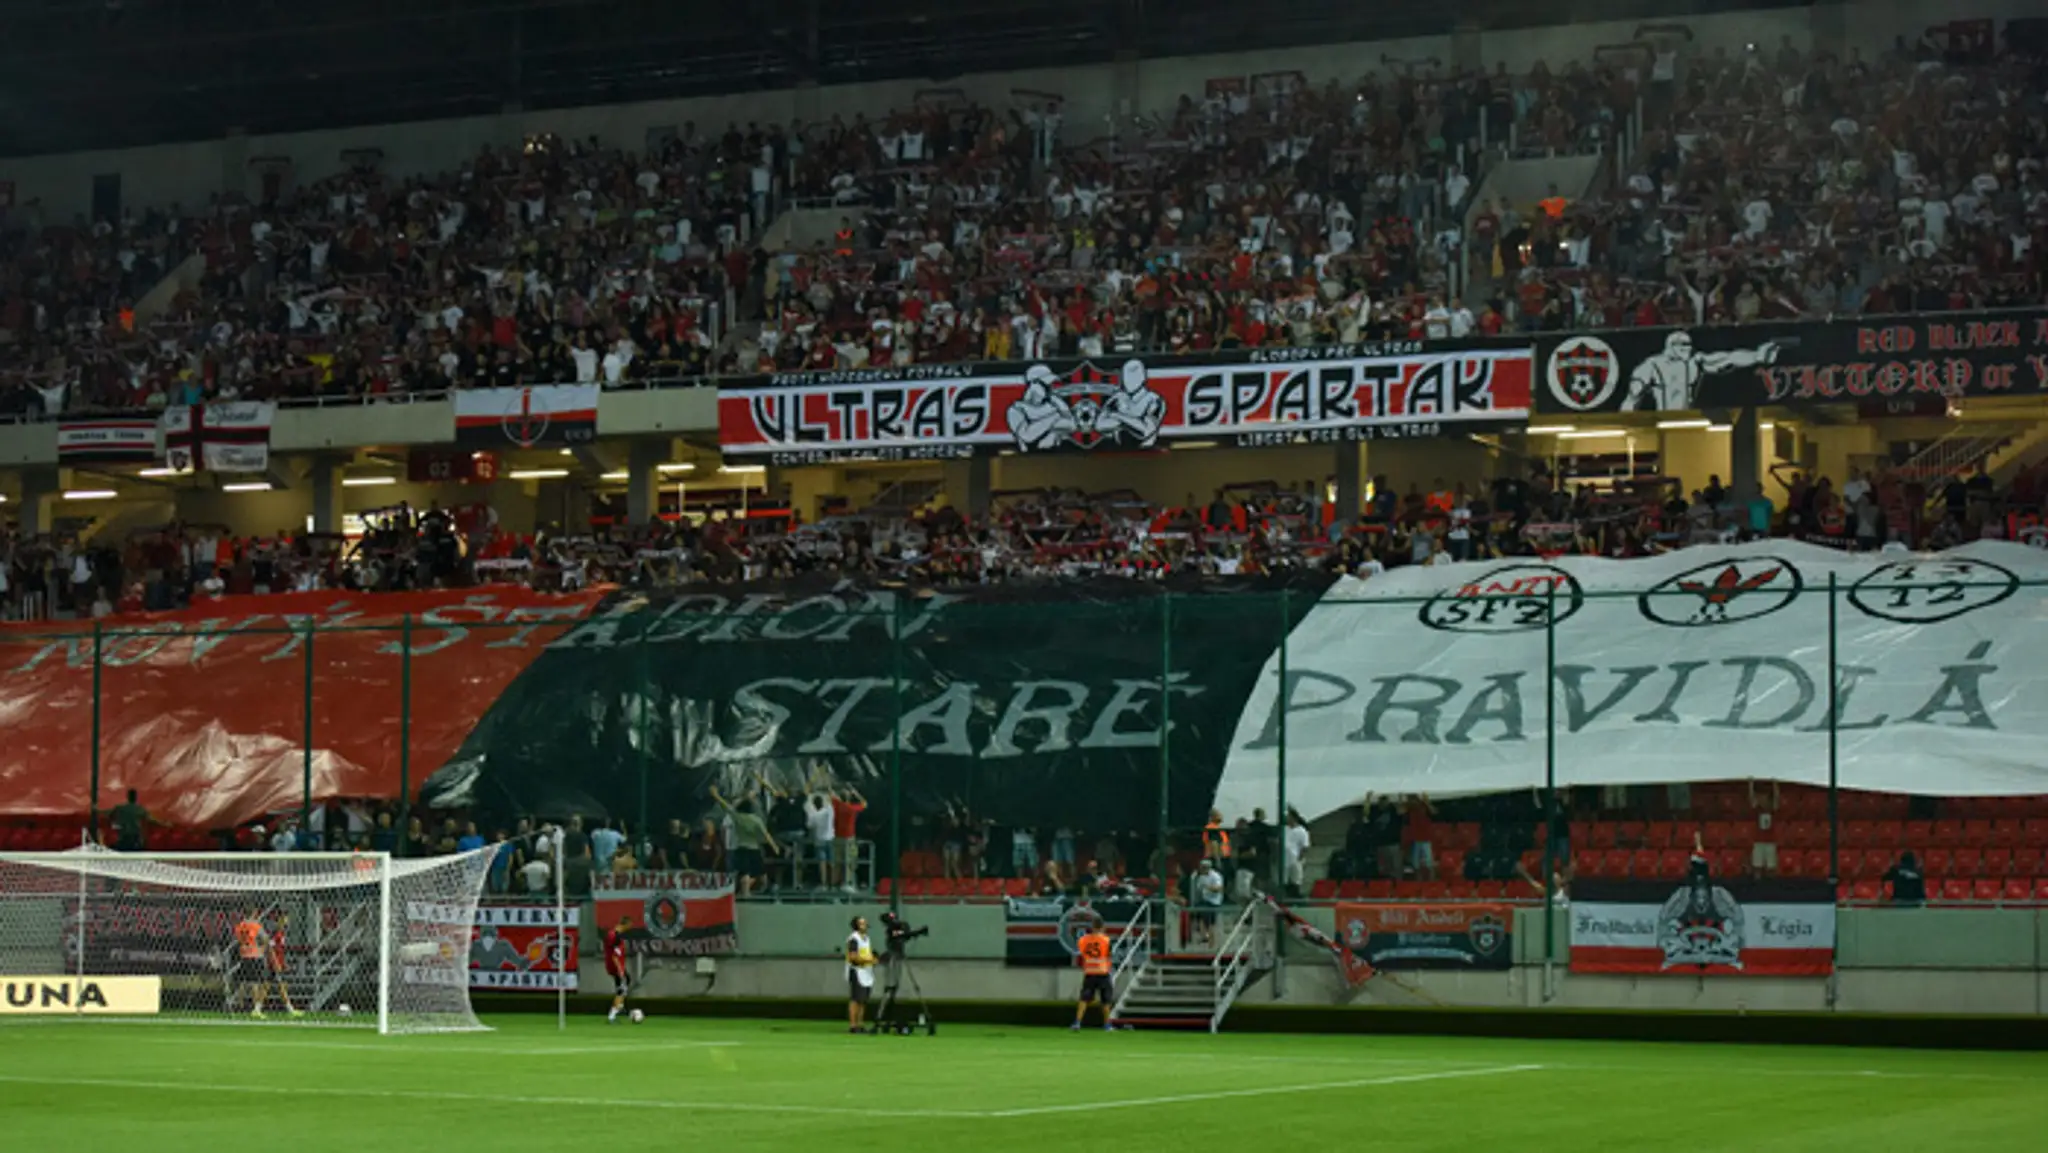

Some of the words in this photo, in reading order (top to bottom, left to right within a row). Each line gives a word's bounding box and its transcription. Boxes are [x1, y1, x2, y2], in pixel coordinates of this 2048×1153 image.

[1857, 327, 1916, 354] RED
[1928, 322, 2020, 350] BLACK
[1188, 358, 1492, 426] SPARTAK
[1755, 357, 1974, 400] VICTORY
[1981, 362, 2017, 391] or
[751, 385, 988, 444] ULTRAS
[1455, 575, 1568, 599] ANTI
[8, 600, 364, 673] NOVÝ
[698, 672, 1209, 763] STARÉ
[1243, 641, 1999, 750] PRAVIDLÁ
[6, 982, 108, 1007] UNA
